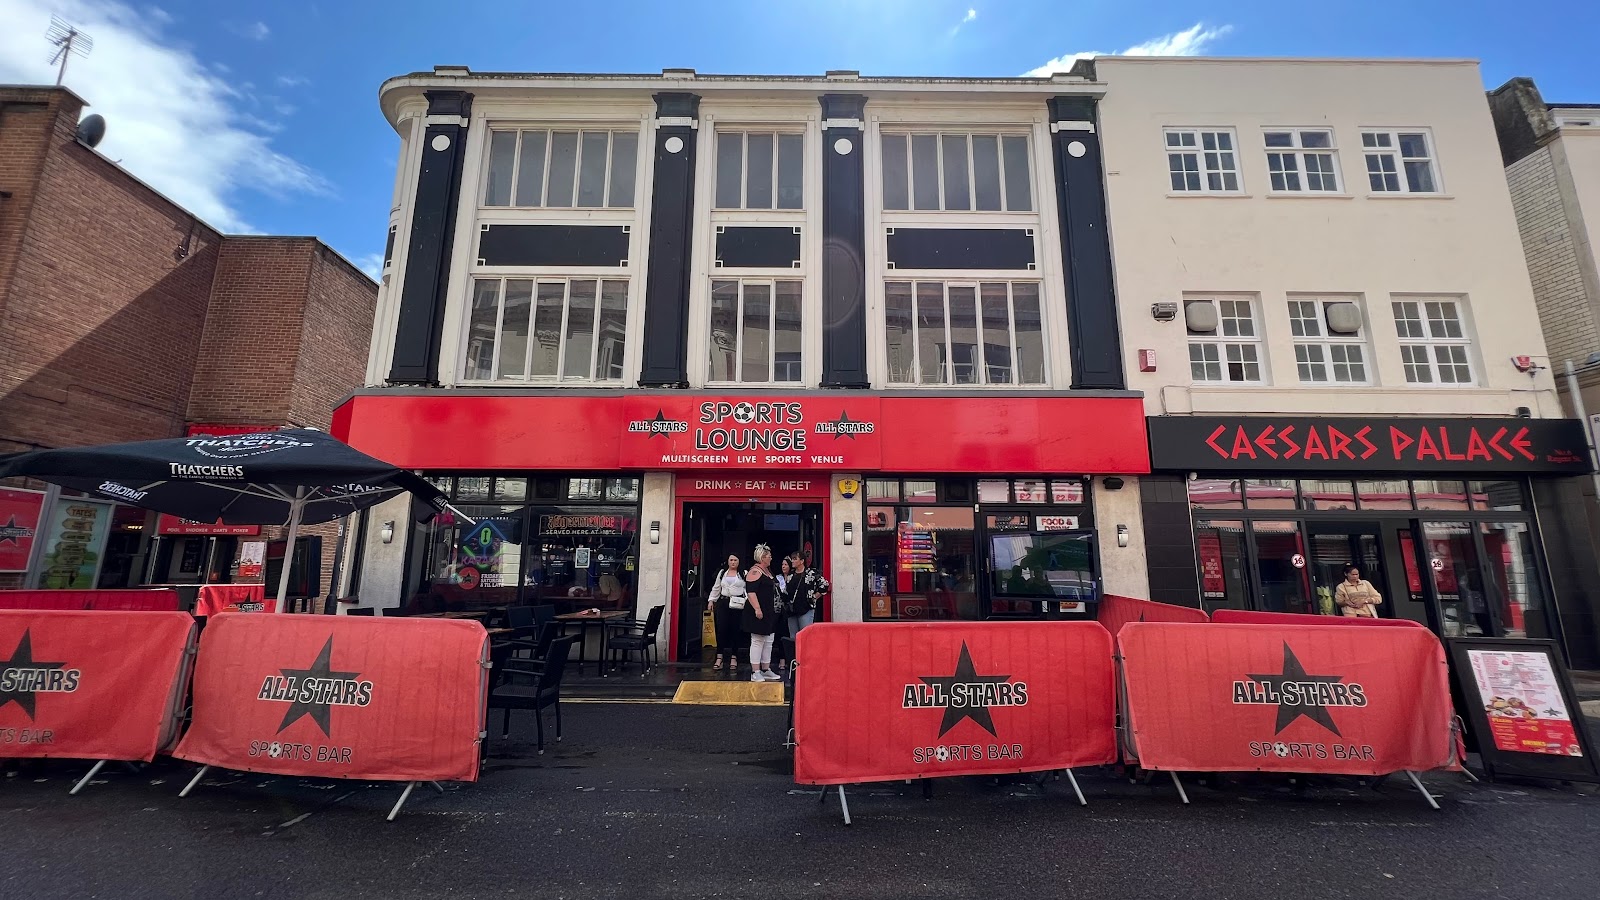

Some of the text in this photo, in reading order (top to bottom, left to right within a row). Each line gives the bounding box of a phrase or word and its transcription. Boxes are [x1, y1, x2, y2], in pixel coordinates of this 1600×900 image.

[700, 401, 803, 424] SPORTS
[628, 421, 688, 433] ALL STARS
[815, 422, 874, 433] ALL STARS
[695, 428, 807, 451] LOUNGE
[1205, 424, 1535, 461] CAESARS PALACE
[169, 462, 244, 476] THATCHERS
[662, 455, 728, 463] MULTISCREEN
[737, 455, 757, 463] LIVE
[765, 456, 802, 464] SPORTS
[695, 480, 811, 490] DRINK EAT MEET
[72, 508, 92, 517] YATES
[1041, 518, 1073, 526] FOOD &
[1, 668, 81, 693] STARS
[257, 675, 374, 707] ALL STARS
[902, 682, 1029, 709] ALL STARS
[1232, 680, 1368, 708] ALL STARS
[18, 728, 55, 745] BAR
[248, 739, 353, 764] SPORTS BAR
[913, 743, 1024, 763] SPORTS BAR
[1249, 741, 1376, 761] SPORTS BAR
